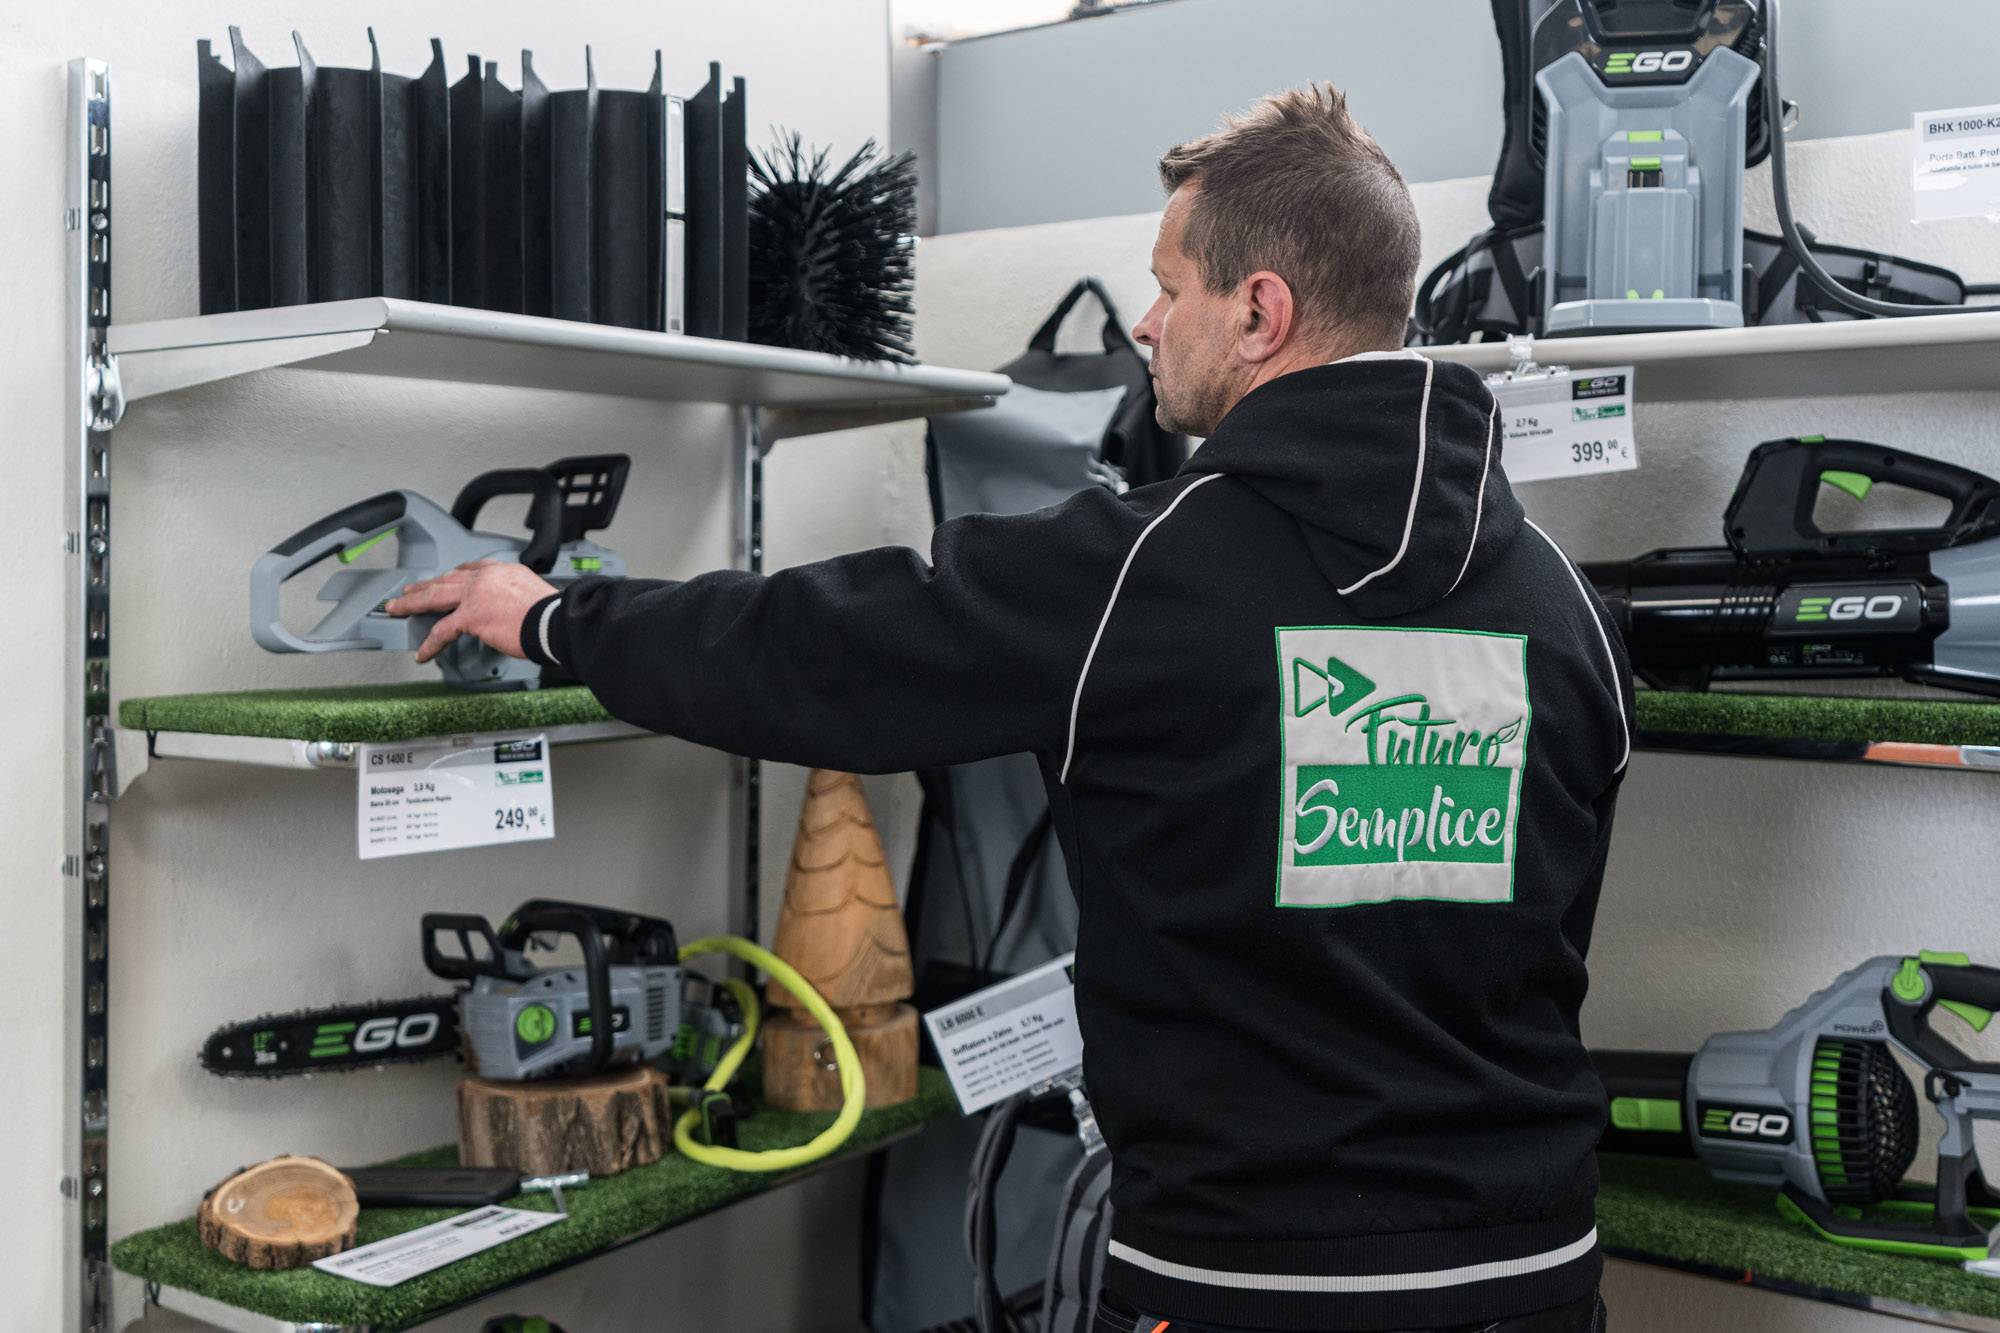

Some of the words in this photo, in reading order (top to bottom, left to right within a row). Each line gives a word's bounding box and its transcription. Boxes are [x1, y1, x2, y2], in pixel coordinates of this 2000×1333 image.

[1604, 50, 1693, 74] EGO
[1929, 121, 1954, 134] BHX
[1578, 376, 1619, 391] EGO
[1795, 594, 1902, 622] EGO
[1345, 693, 1502, 769] Futuro
[371, 754, 384, 766] CS
[407, 751, 413, 763] E
[1294, 779, 1506, 863] Semplice
[309, 1012, 440, 1058] EGO
[1833, 1023, 1877, 1033] POWER
[1702, 1108, 1790, 1137] EGO
